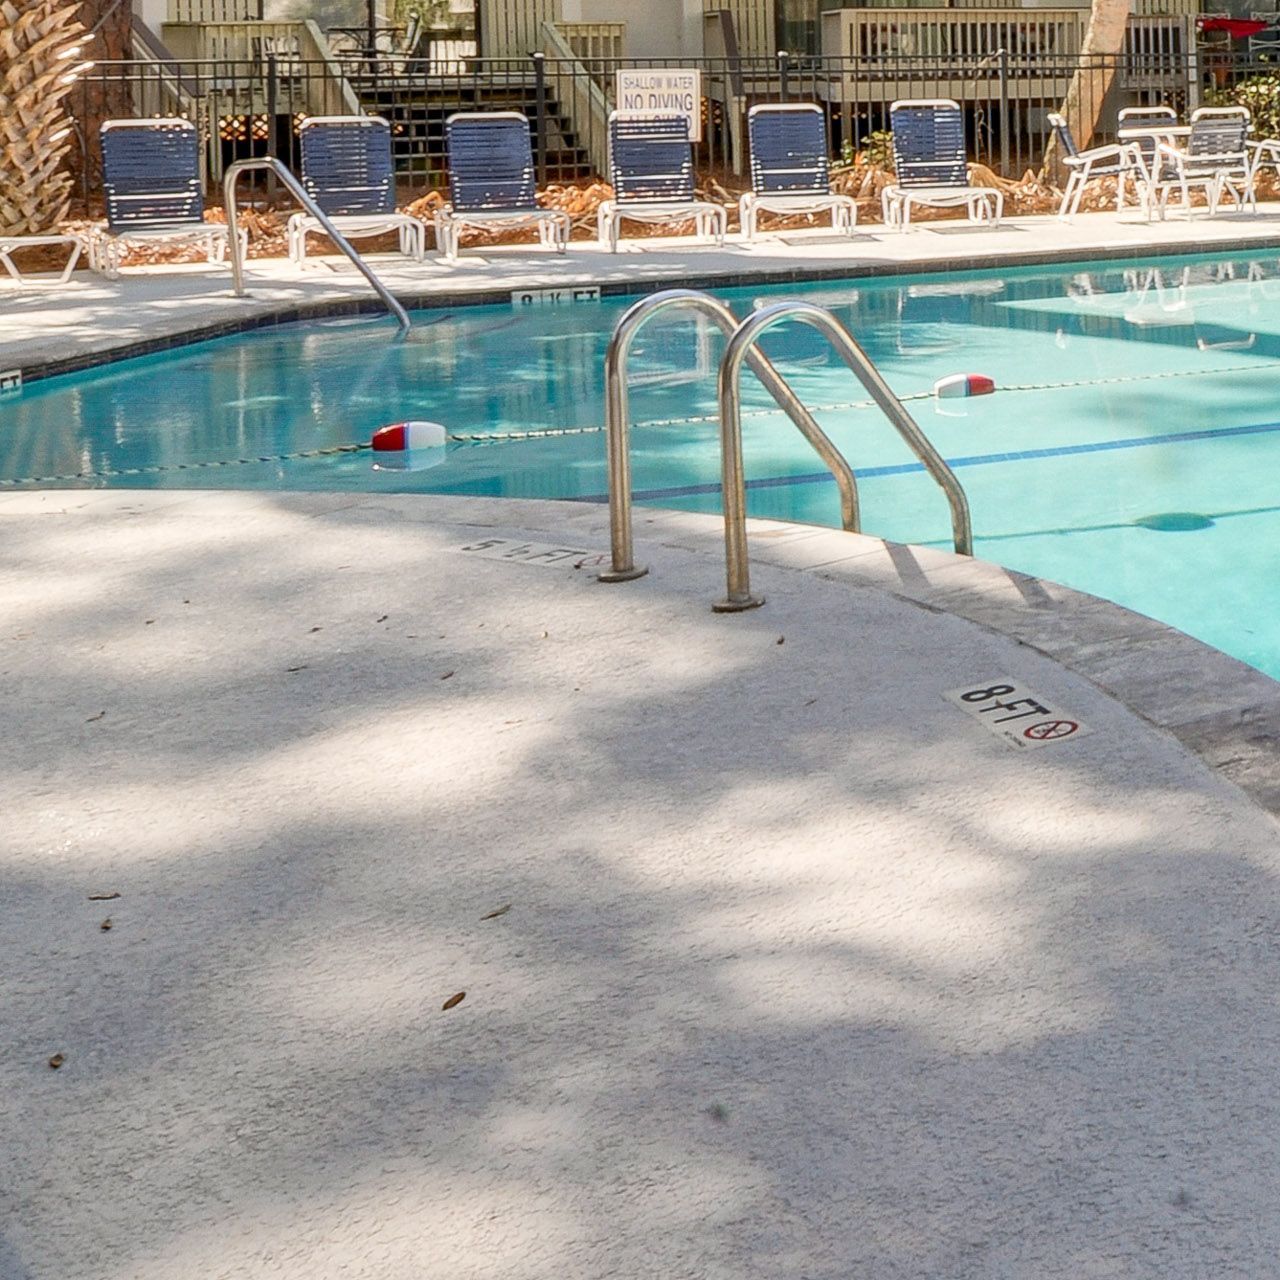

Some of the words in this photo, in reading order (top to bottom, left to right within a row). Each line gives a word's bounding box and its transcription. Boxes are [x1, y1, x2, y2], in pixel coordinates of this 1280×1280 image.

[624, 76, 663, 90] SHALLOW
[666, 76, 693, 90] WATER
[624, 93, 643, 110] NO
[648, 92, 693, 112] DIVING
[526, 549, 588, 564] FT
[960, 684, 1016, 703] 8
[978, 697, 1052, 724] FT
